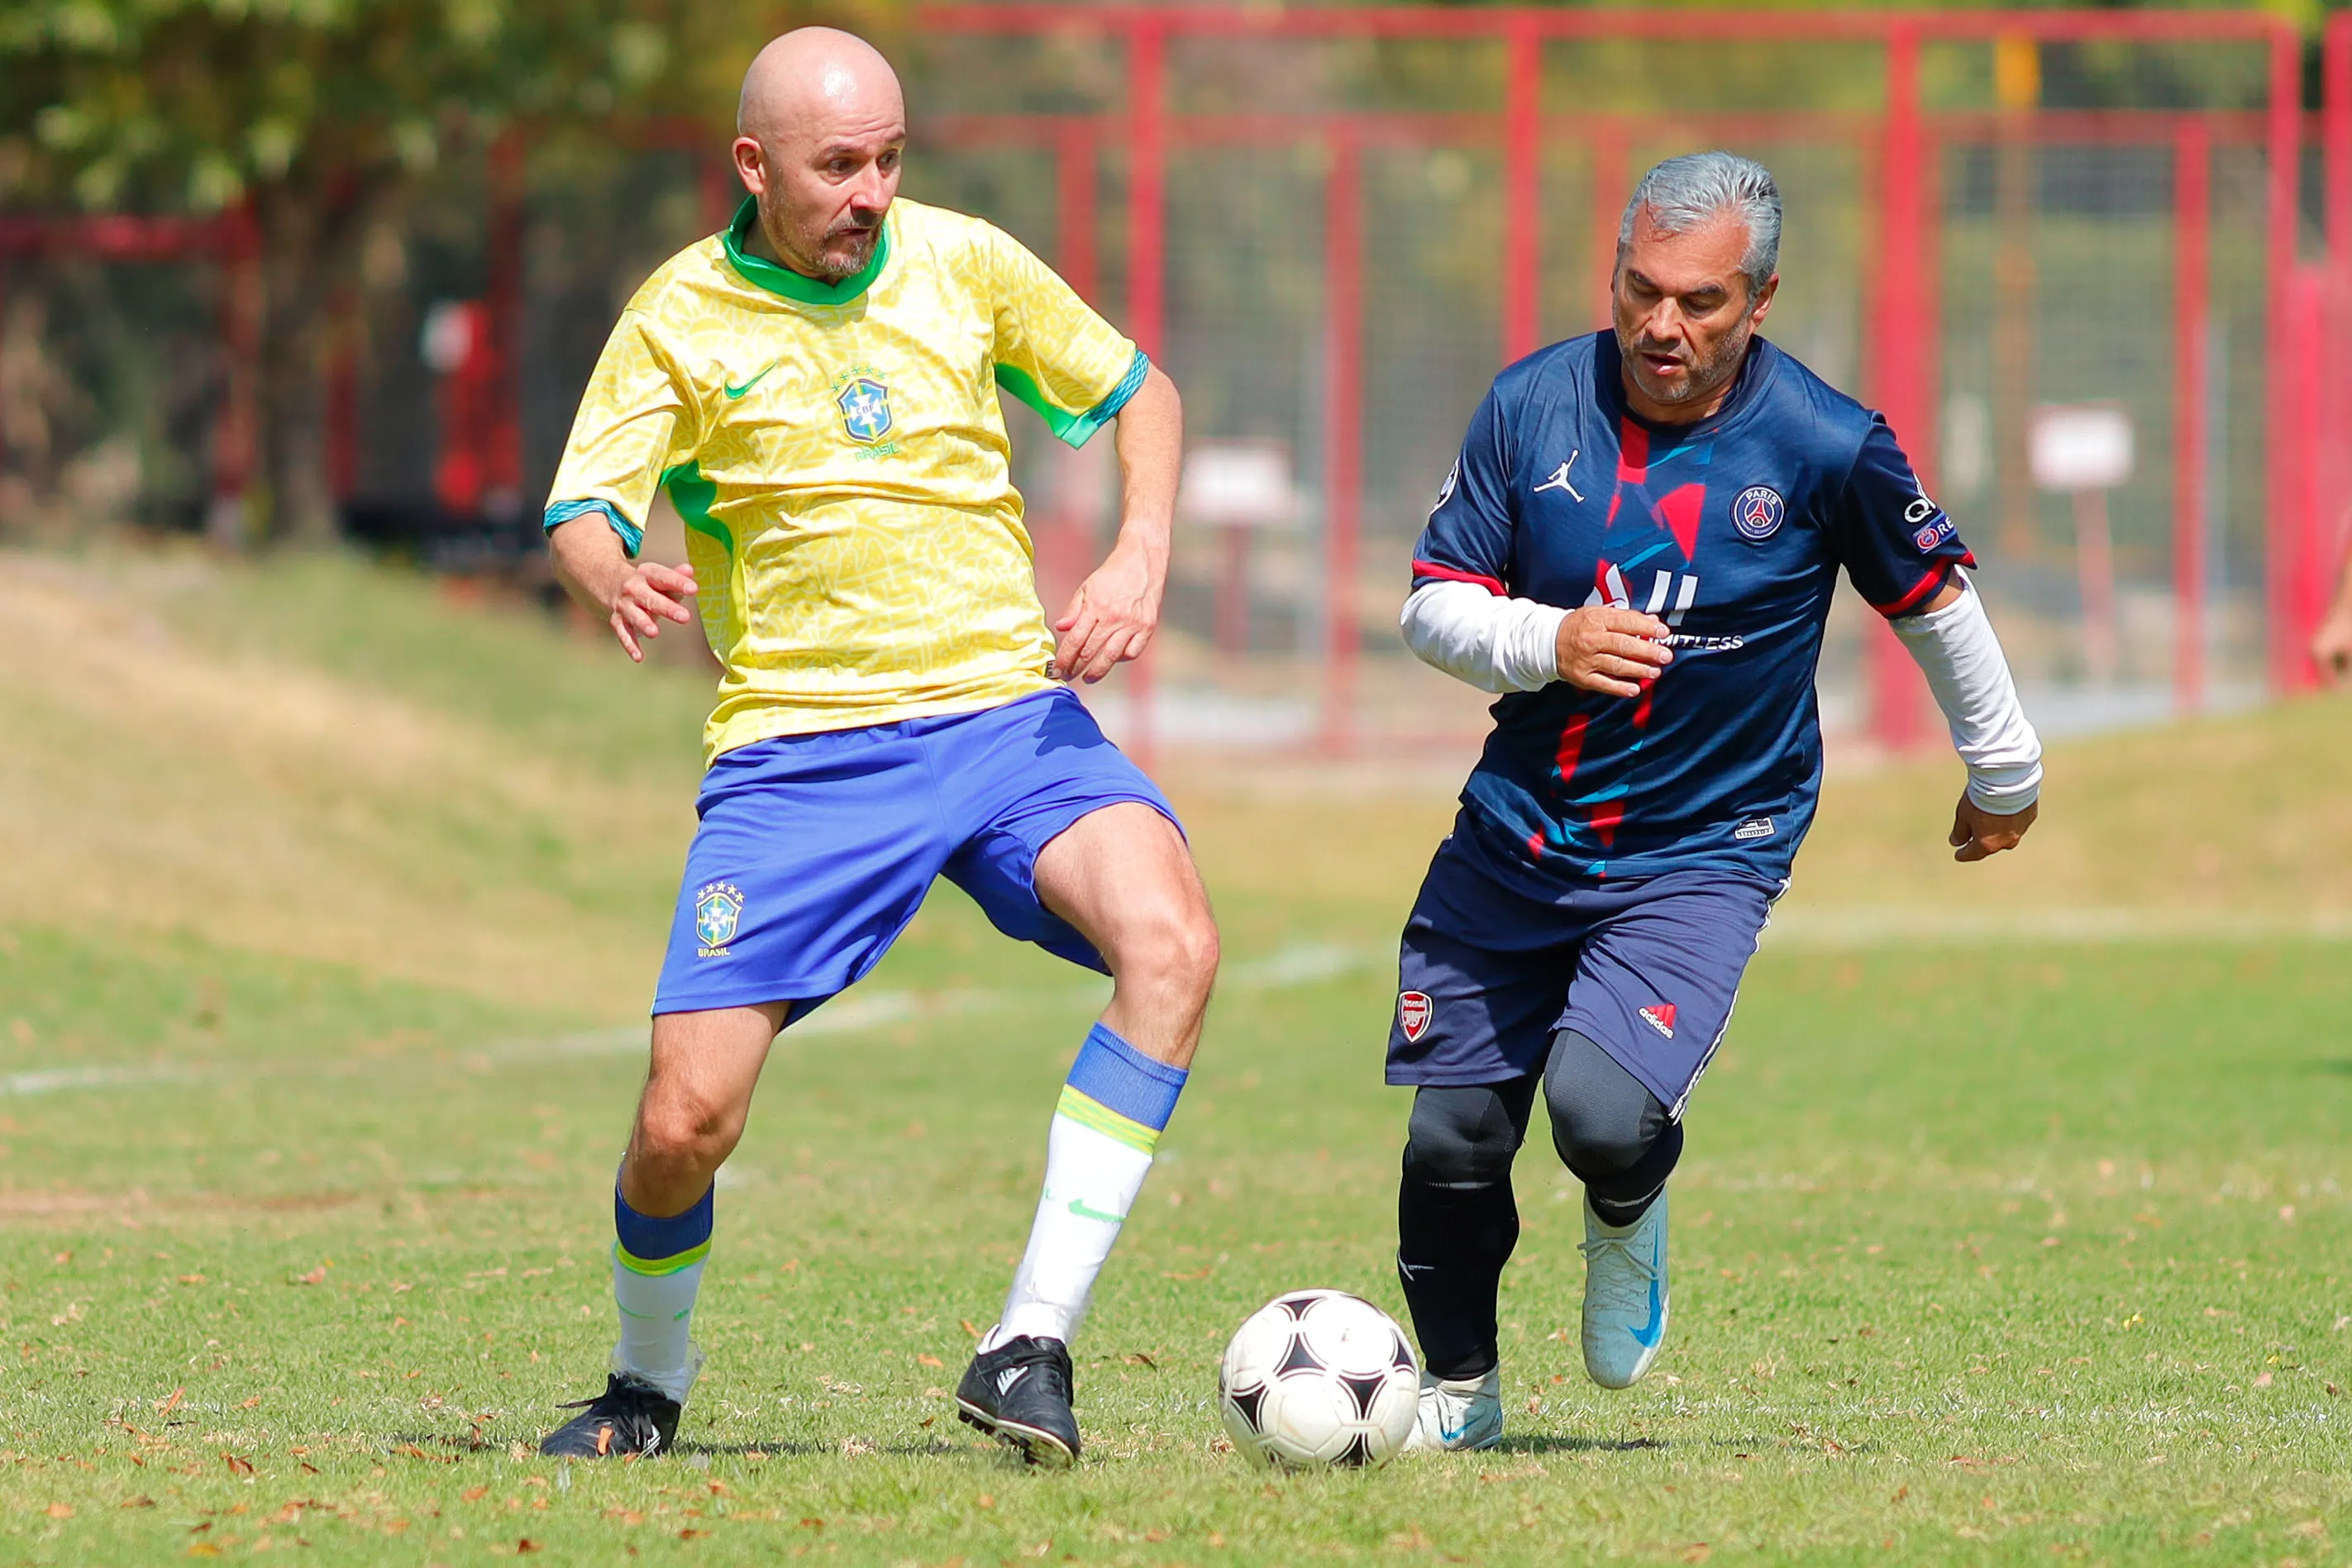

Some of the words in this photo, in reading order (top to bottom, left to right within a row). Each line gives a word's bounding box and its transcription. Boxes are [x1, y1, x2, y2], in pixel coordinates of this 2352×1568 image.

[855, 441, 899, 463] BRASIL
[1745, 489, 1778, 506] PARIS
[698, 947, 731, 957] BRASIL
[1639, 1007, 1675, 1039] adidas
